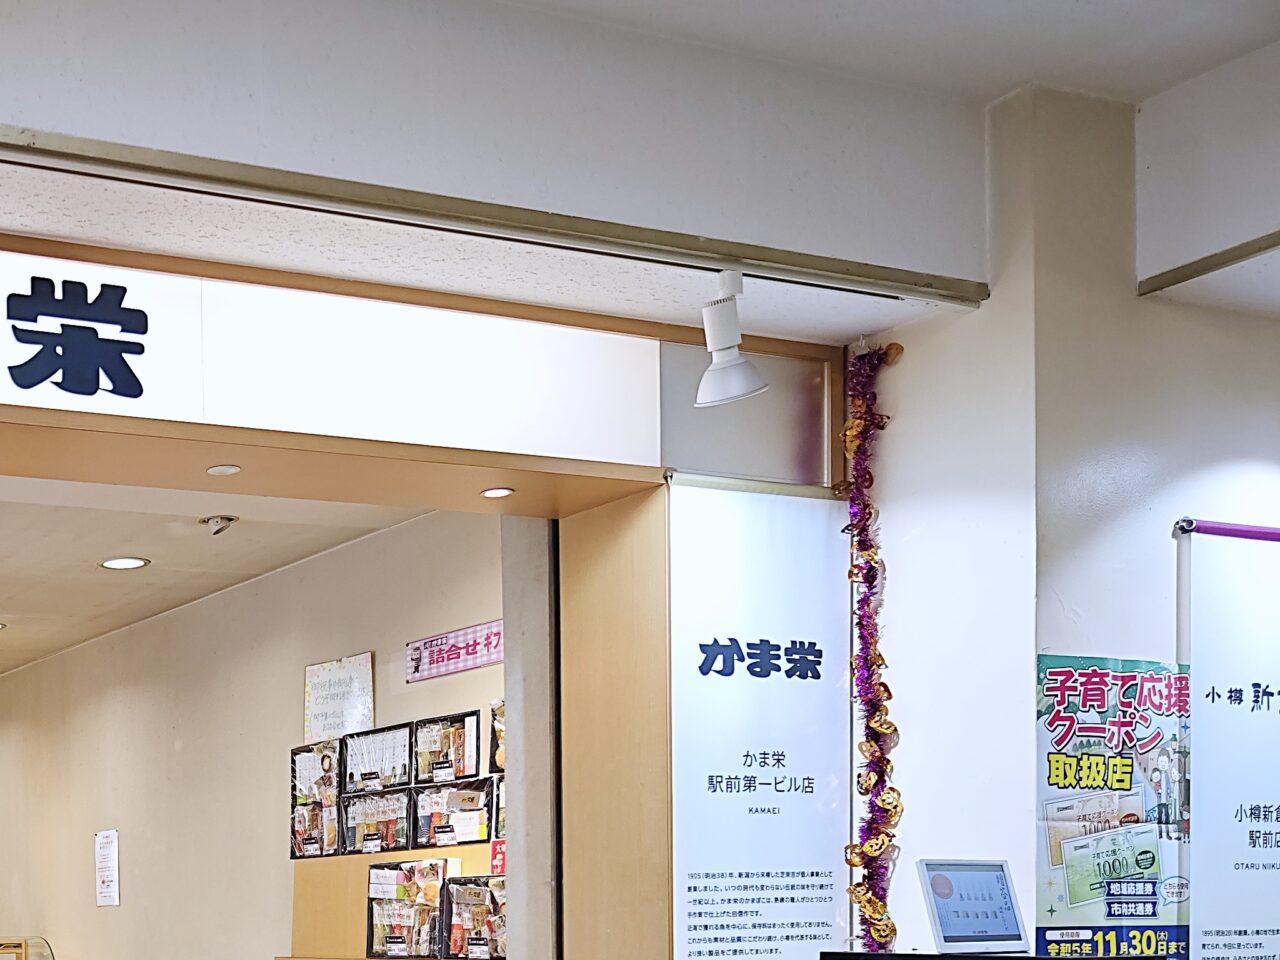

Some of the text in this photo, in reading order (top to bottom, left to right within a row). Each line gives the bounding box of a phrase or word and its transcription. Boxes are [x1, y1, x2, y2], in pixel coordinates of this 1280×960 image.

[698, 637, 823, 680] かま栄
[1045, 667, 1190, 714] 子育て応援
[1047, 709, 1163, 751] クーポン
[742, 750, 786, 768] かま栄
[1047, 754, 1133, 791] 取扱店
[707, 775, 815, 794] 駅前第一ビル店
[748, 807, 781, 815] KAMAEI
[1234, 862, 1260, 870] OTARU
